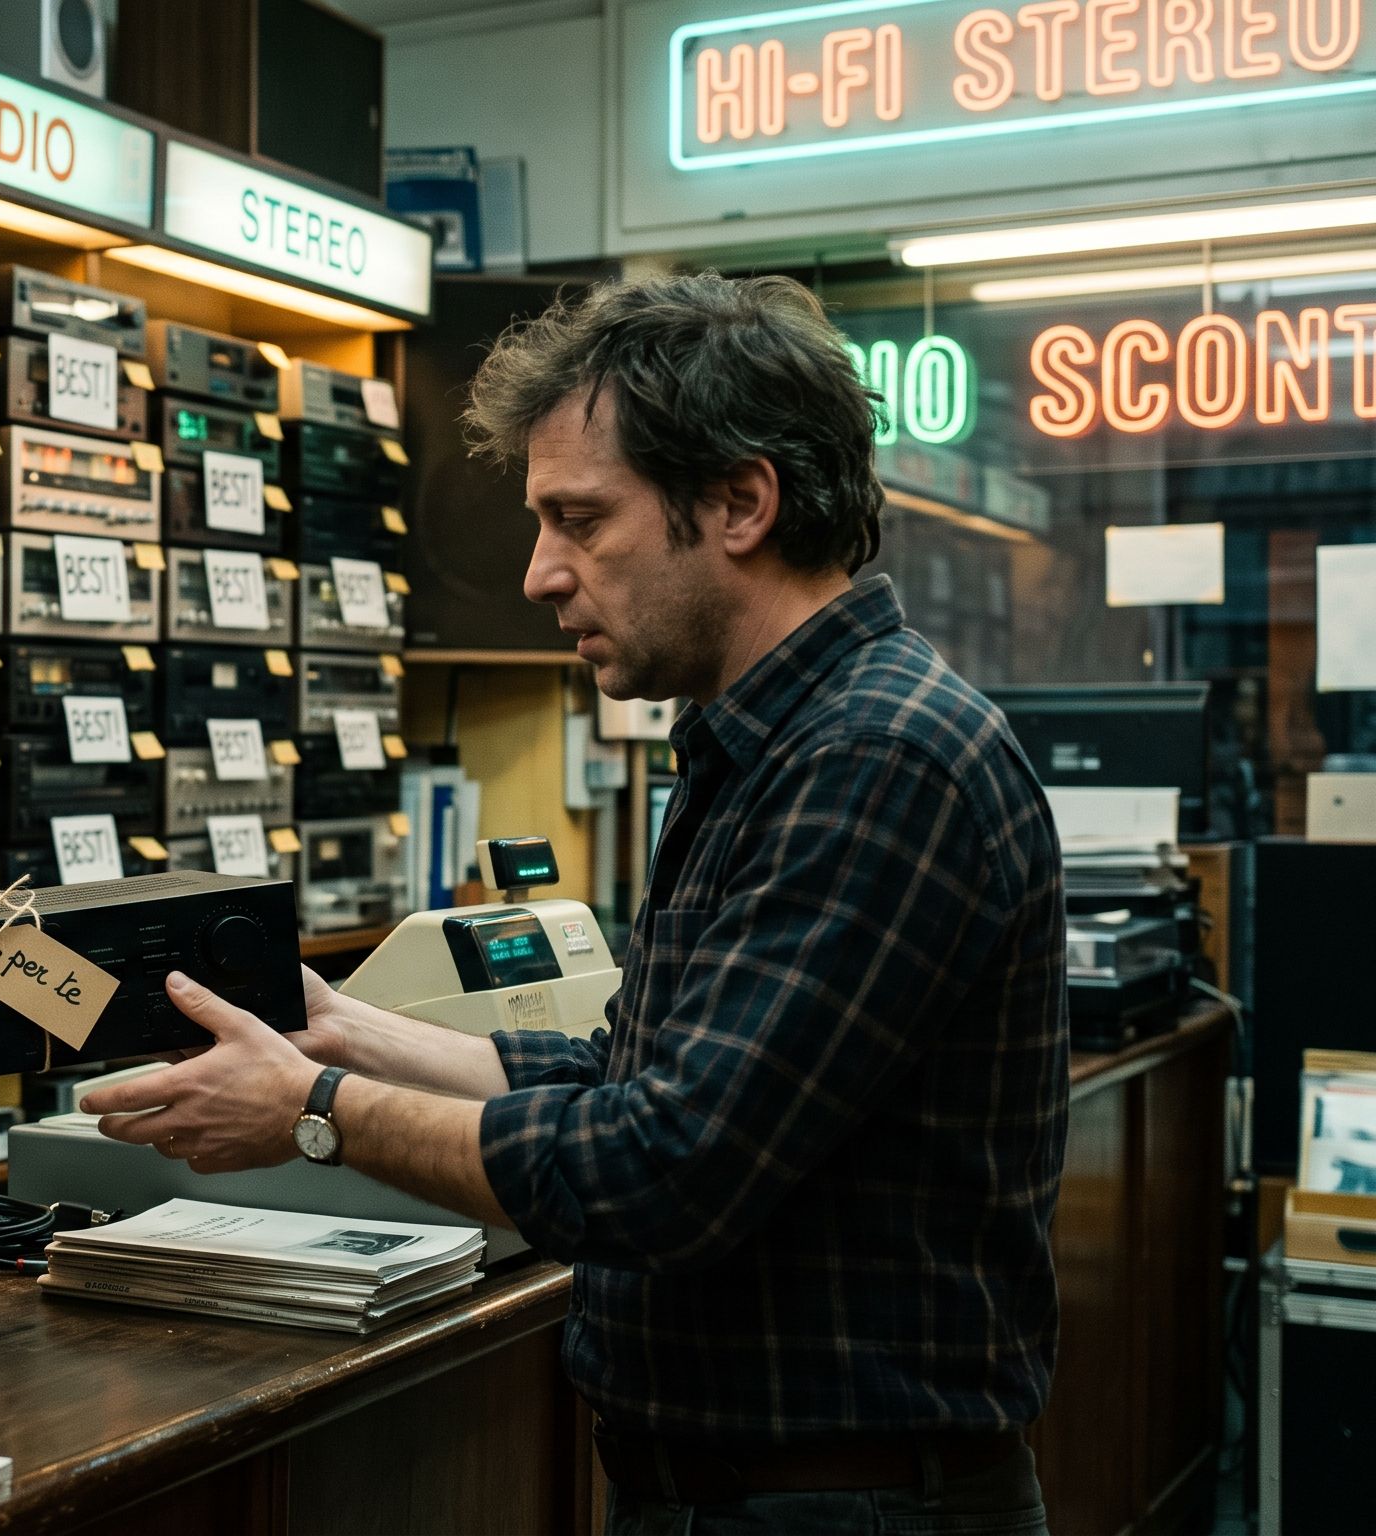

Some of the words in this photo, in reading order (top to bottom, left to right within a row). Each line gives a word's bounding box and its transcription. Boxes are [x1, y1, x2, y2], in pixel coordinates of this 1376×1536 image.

[695, 22, 902, 143] HI-FI
[953, 0, 1360, 112] STEREO
[241, 188, 367, 277] STEREO
[55, 353, 112, 410] BEST!
[846, 335, 969, 446] IO
[63, 553, 122, 604] BEST!
[71, 708, 122, 748] BEST!
[60, 827, 115, 867] BEST!
[0, 949, 49, 986] per
[54, 970, 82, 1006] te
